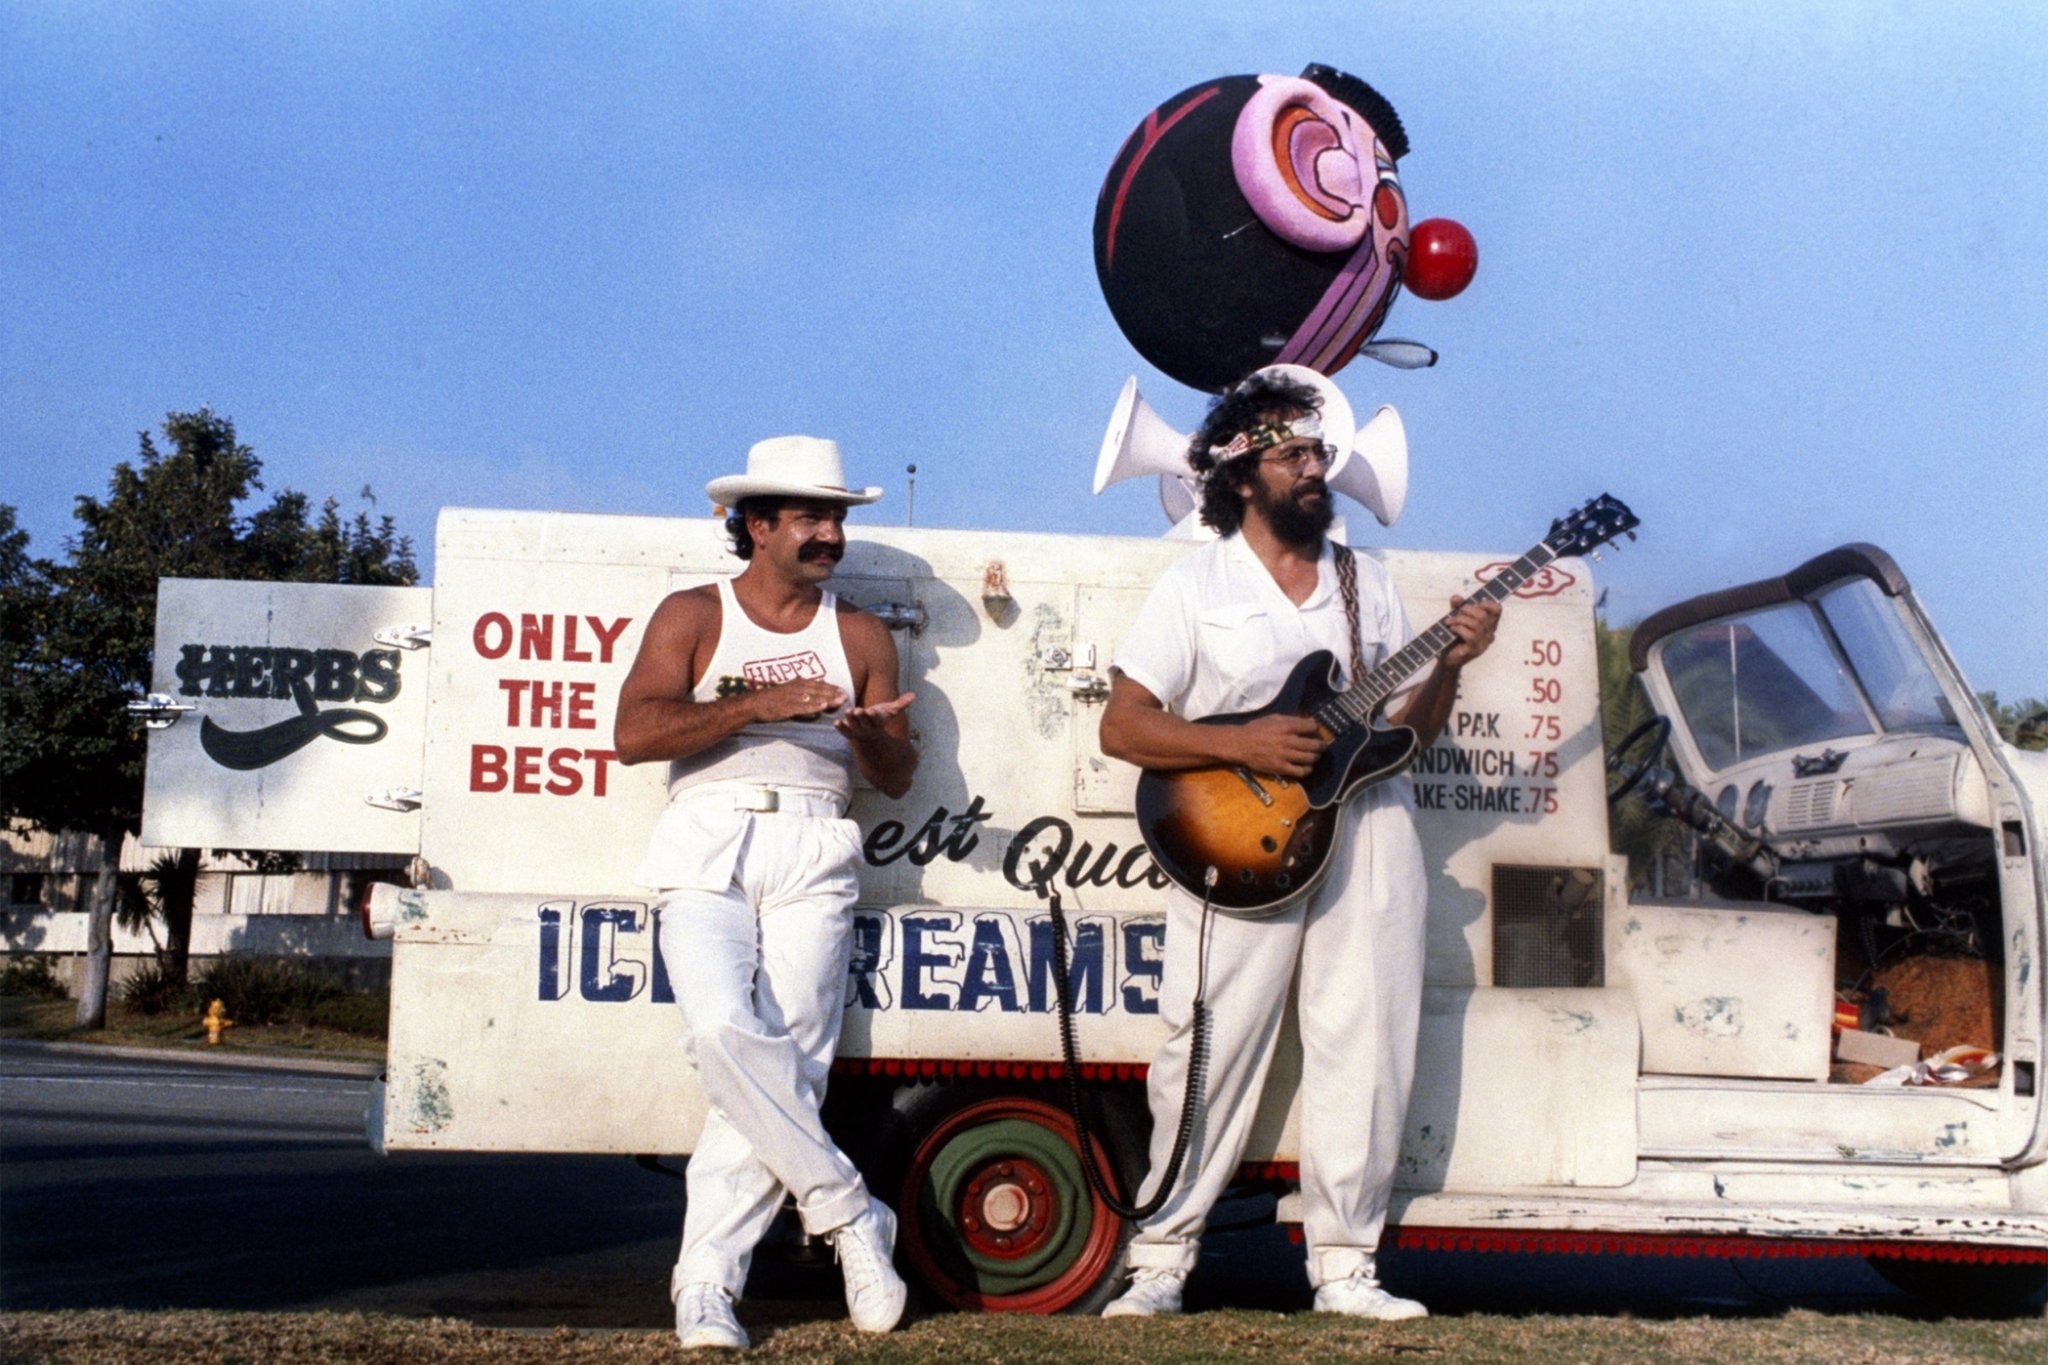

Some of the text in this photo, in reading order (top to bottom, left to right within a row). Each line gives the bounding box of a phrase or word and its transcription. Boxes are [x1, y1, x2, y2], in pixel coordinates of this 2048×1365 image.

[473, 611, 633, 663] ONLY
[1524, 640, 1562, 666] .50
[747, 657, 817, 689] HAPPY
[499, 679, 596, 729] THE
[1526, 678, 1562, 703] .50
[1457, 712, 1500, 738] PAK
[1524, 715, 1562, 740] .75
[469, 744, 620, 797] BEST
[1411, 747, 1559, 778] NDWICH .75
[1524, 788, 1559, 814] .75
